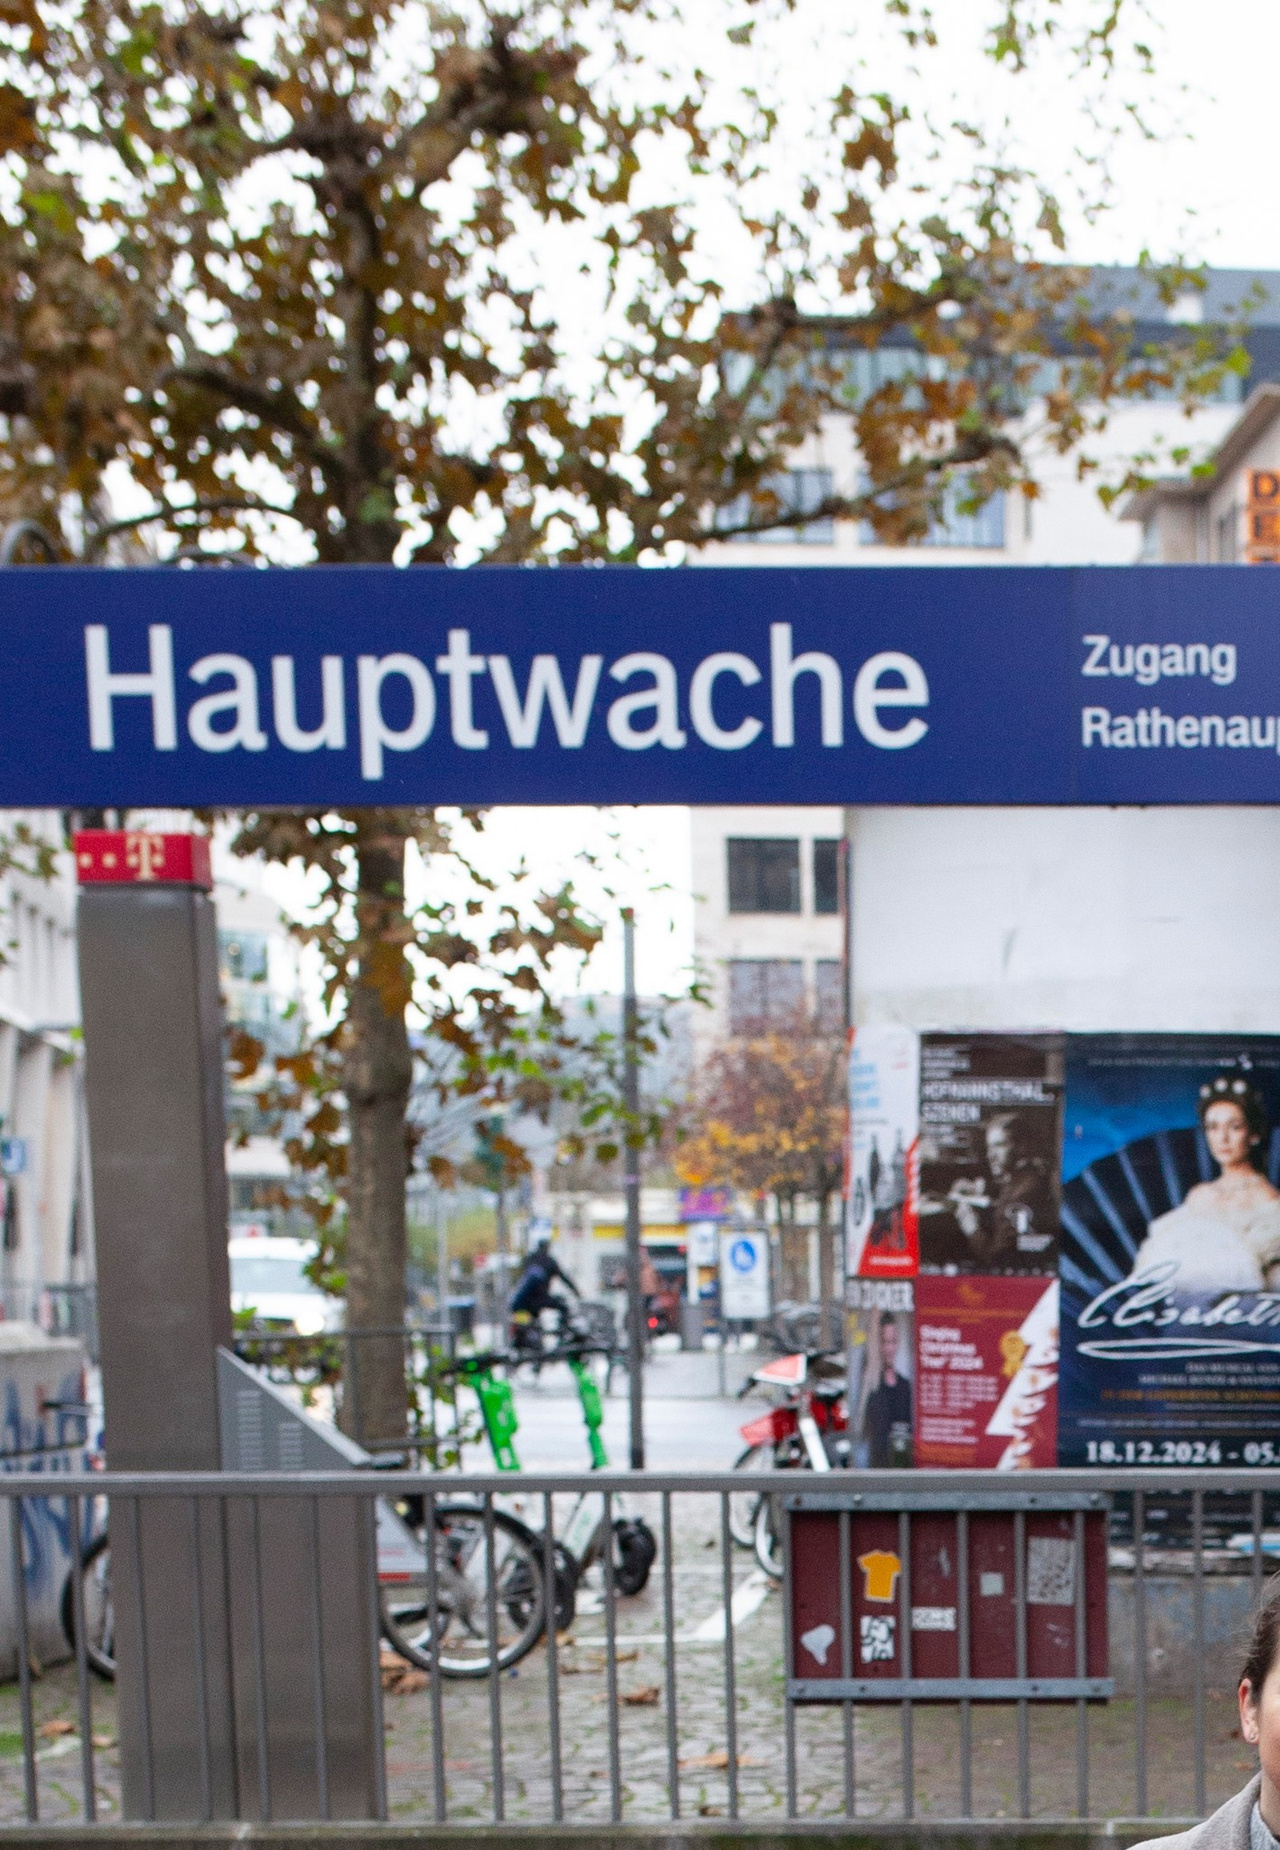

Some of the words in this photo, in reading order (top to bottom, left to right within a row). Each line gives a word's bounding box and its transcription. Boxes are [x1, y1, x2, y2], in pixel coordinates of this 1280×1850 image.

[1082, 634, 1237, 685] Zugang
[86, 622, 929, 779] Hauptwache
[1085, 1440, 1221, 1464] 18.12.2024
